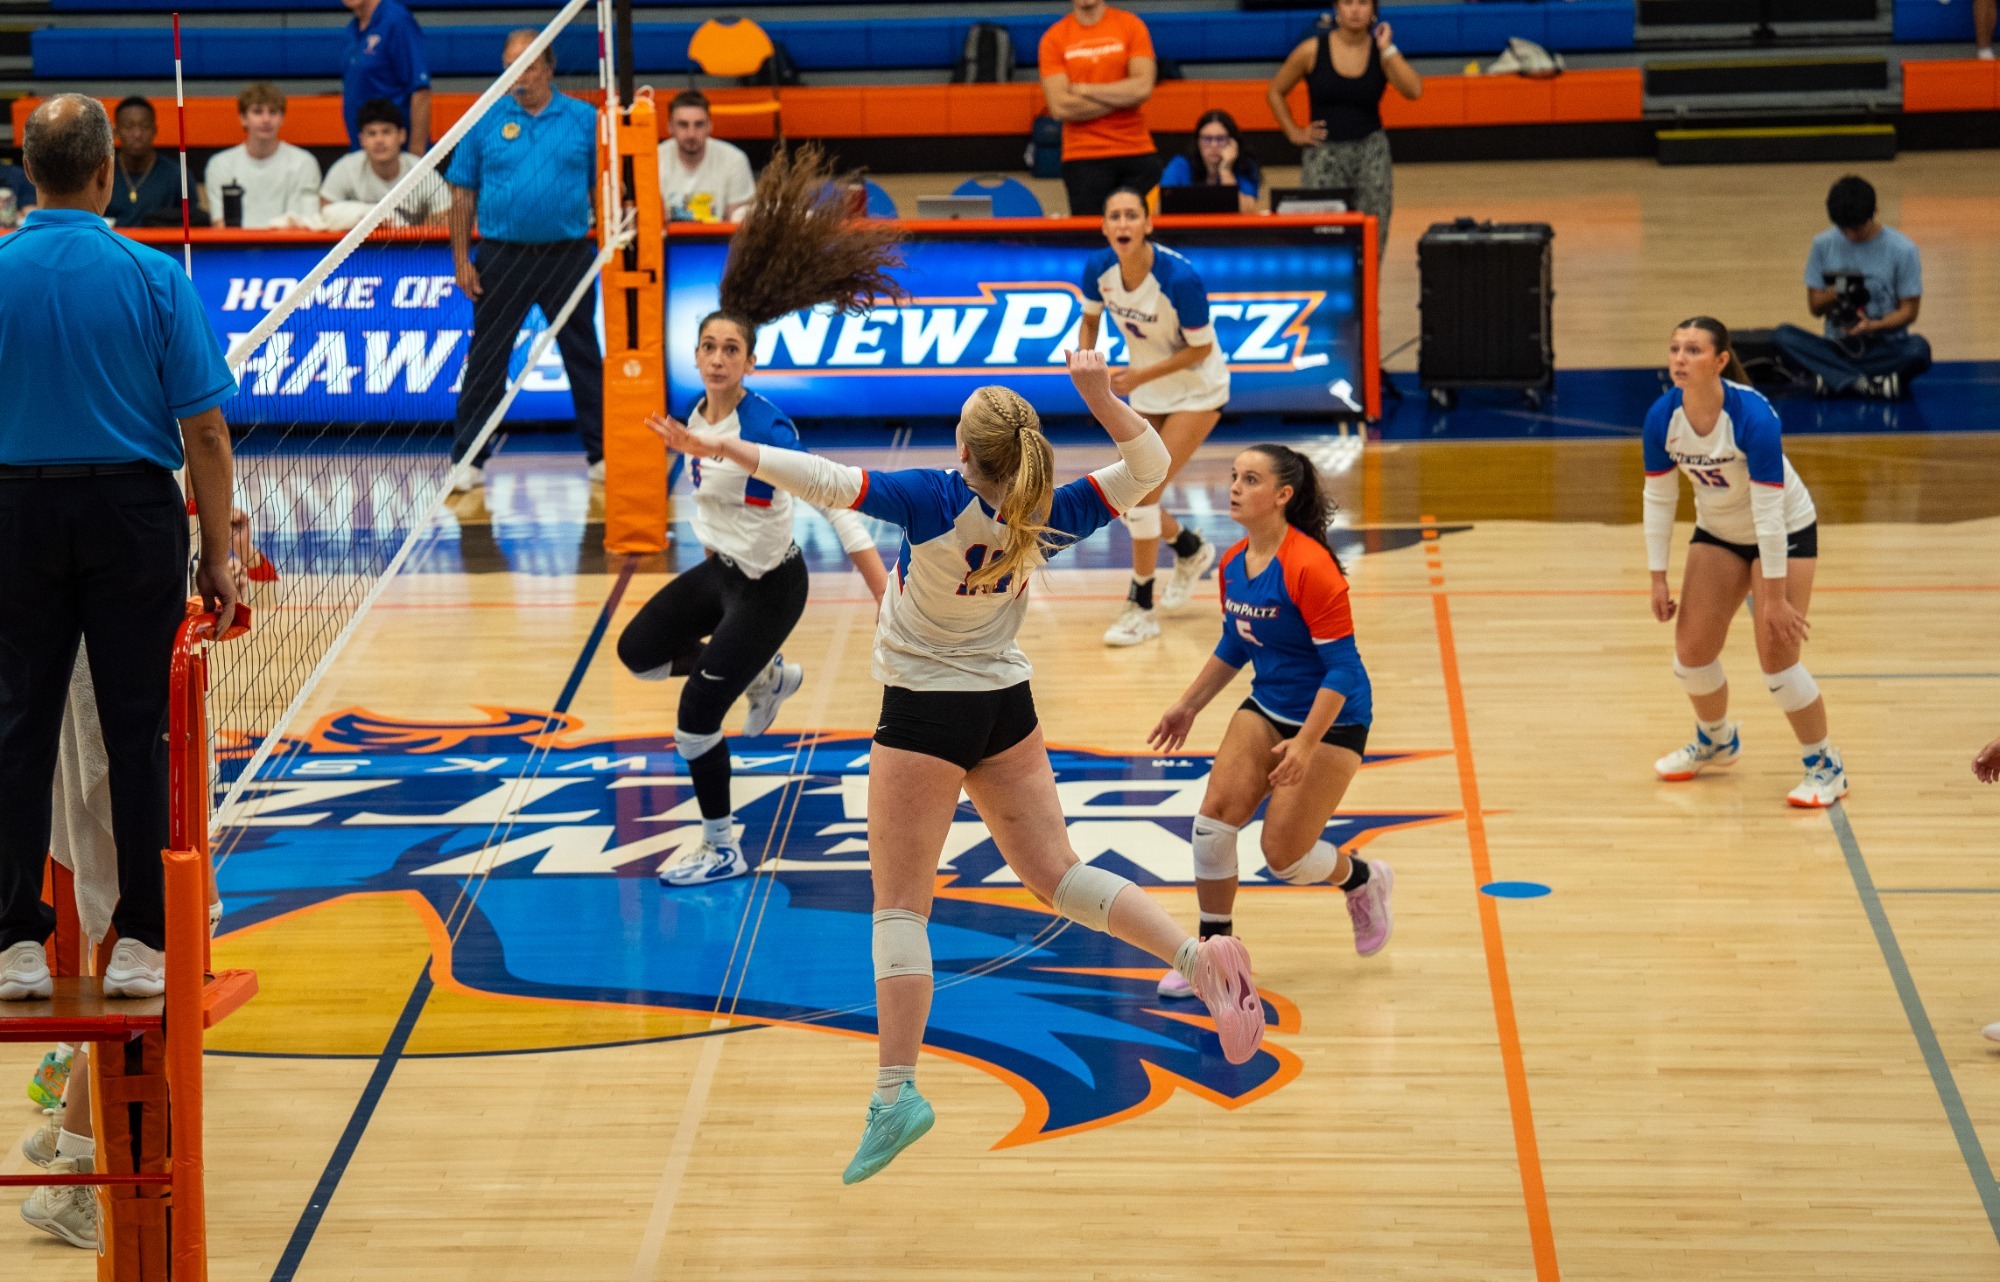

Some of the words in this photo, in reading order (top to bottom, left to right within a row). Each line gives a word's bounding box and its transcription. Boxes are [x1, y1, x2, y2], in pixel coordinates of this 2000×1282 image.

[222, 276, 382, 311] HOME
[391, 276, 457, 310] OF
[984, 292, 1299, 365] PAZ
[1689, 468, 1730, 488] 15
[1236, 619, 1264, 648] 5
[291, 752, 871, 774] AWKS
[215, 759, 1214, 828] PLTZ
